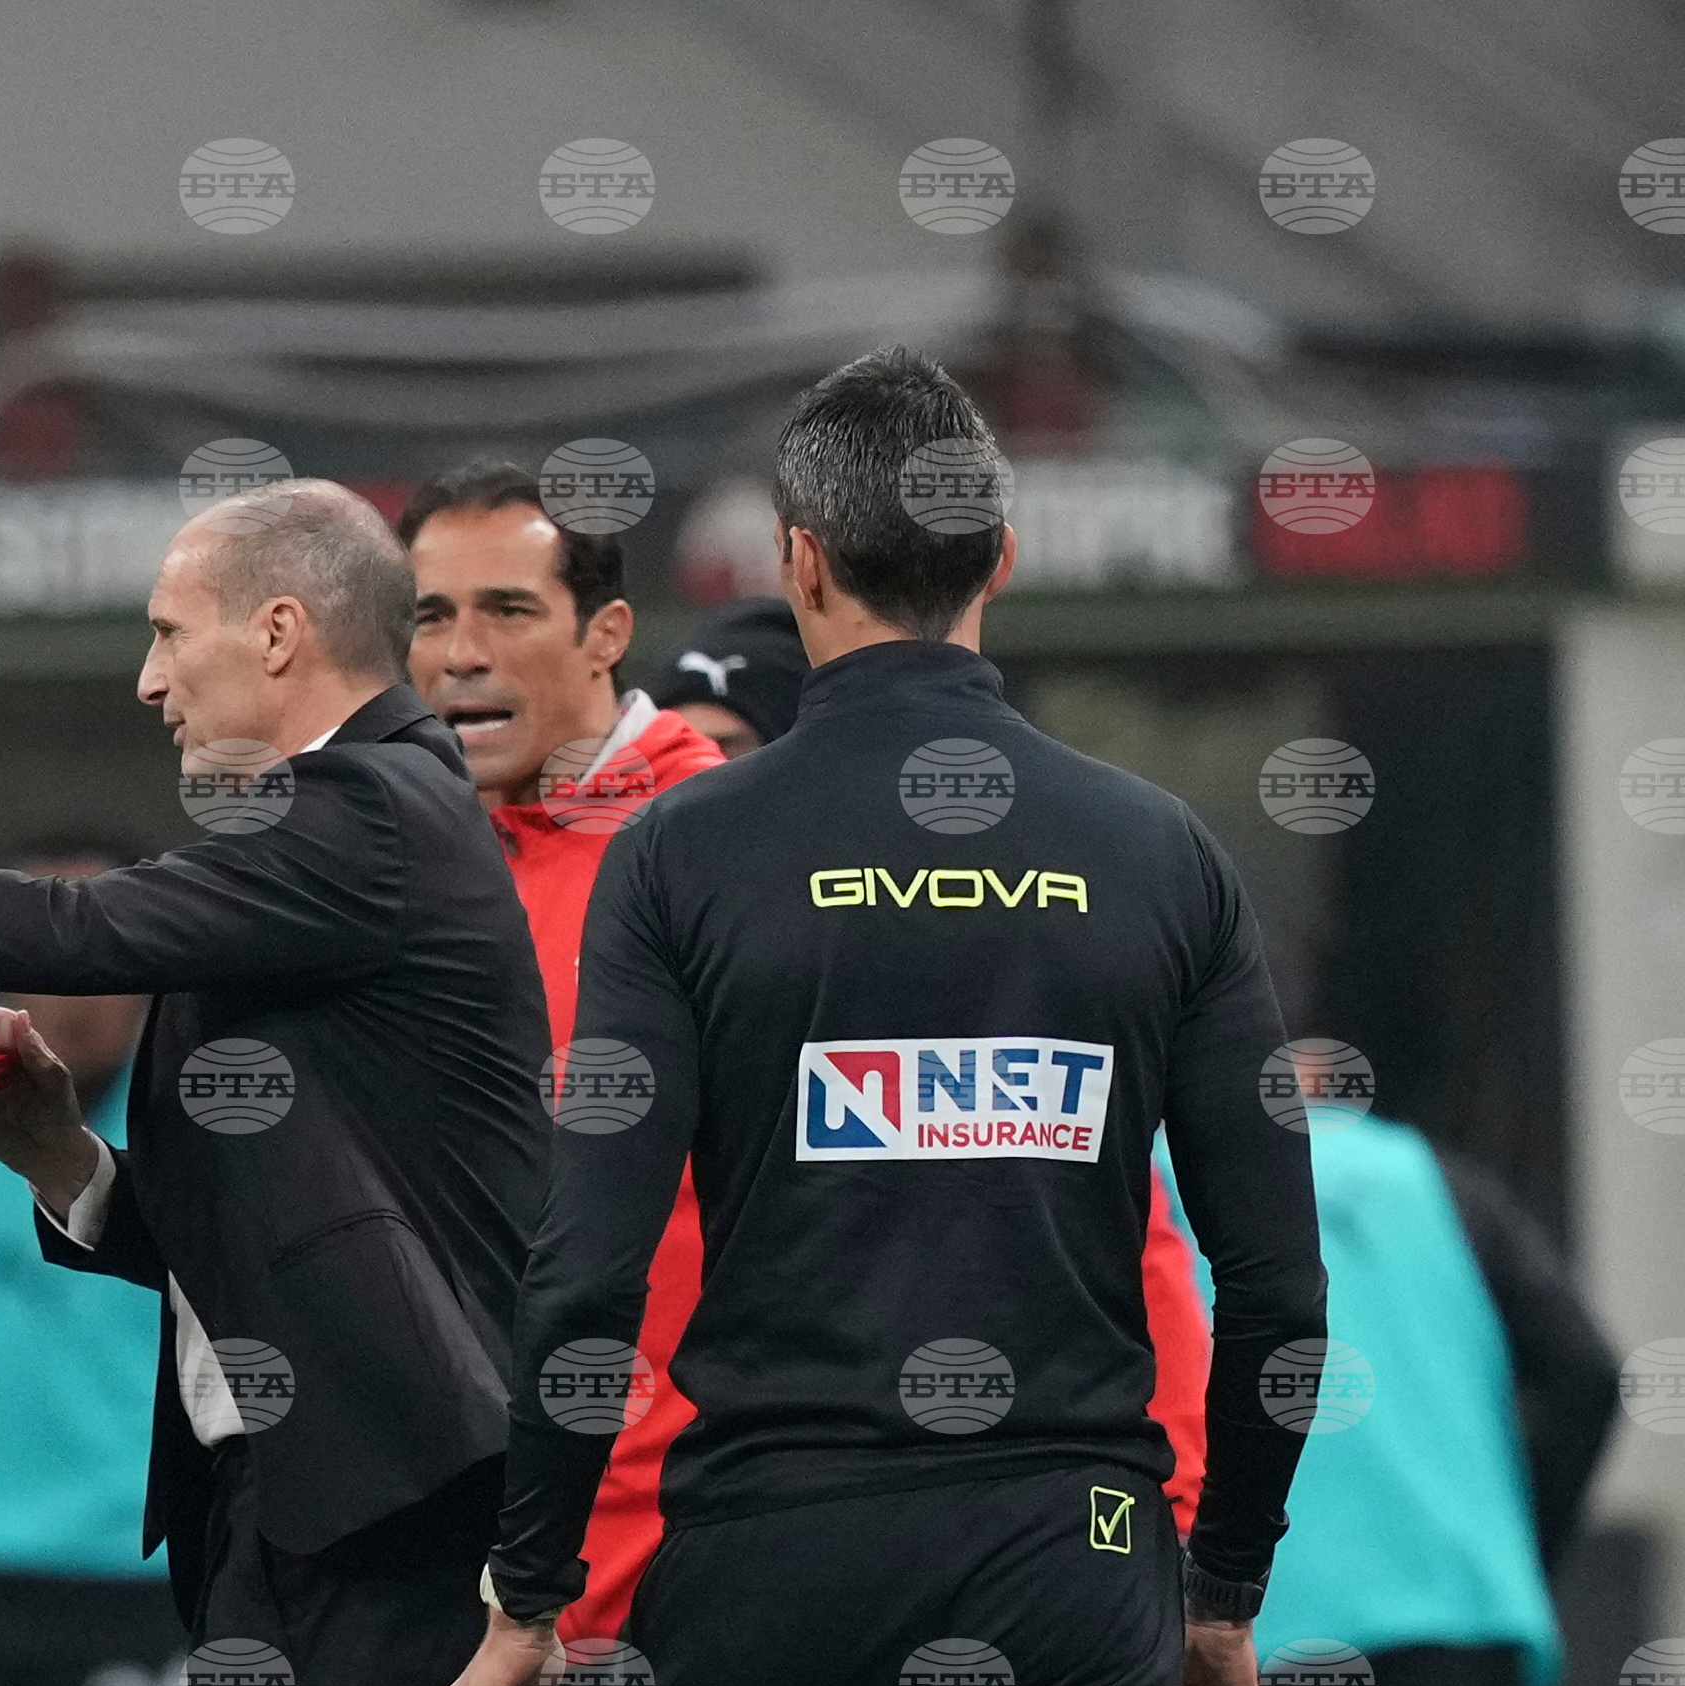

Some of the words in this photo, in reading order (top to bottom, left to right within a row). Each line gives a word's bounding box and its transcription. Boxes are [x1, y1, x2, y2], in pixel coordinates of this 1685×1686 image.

[809, 867, 1089, 913] GIVOVA
[917, 1049, 1105, 1115] NET
[917, 1121, 1094, 1152] INSURANCE
